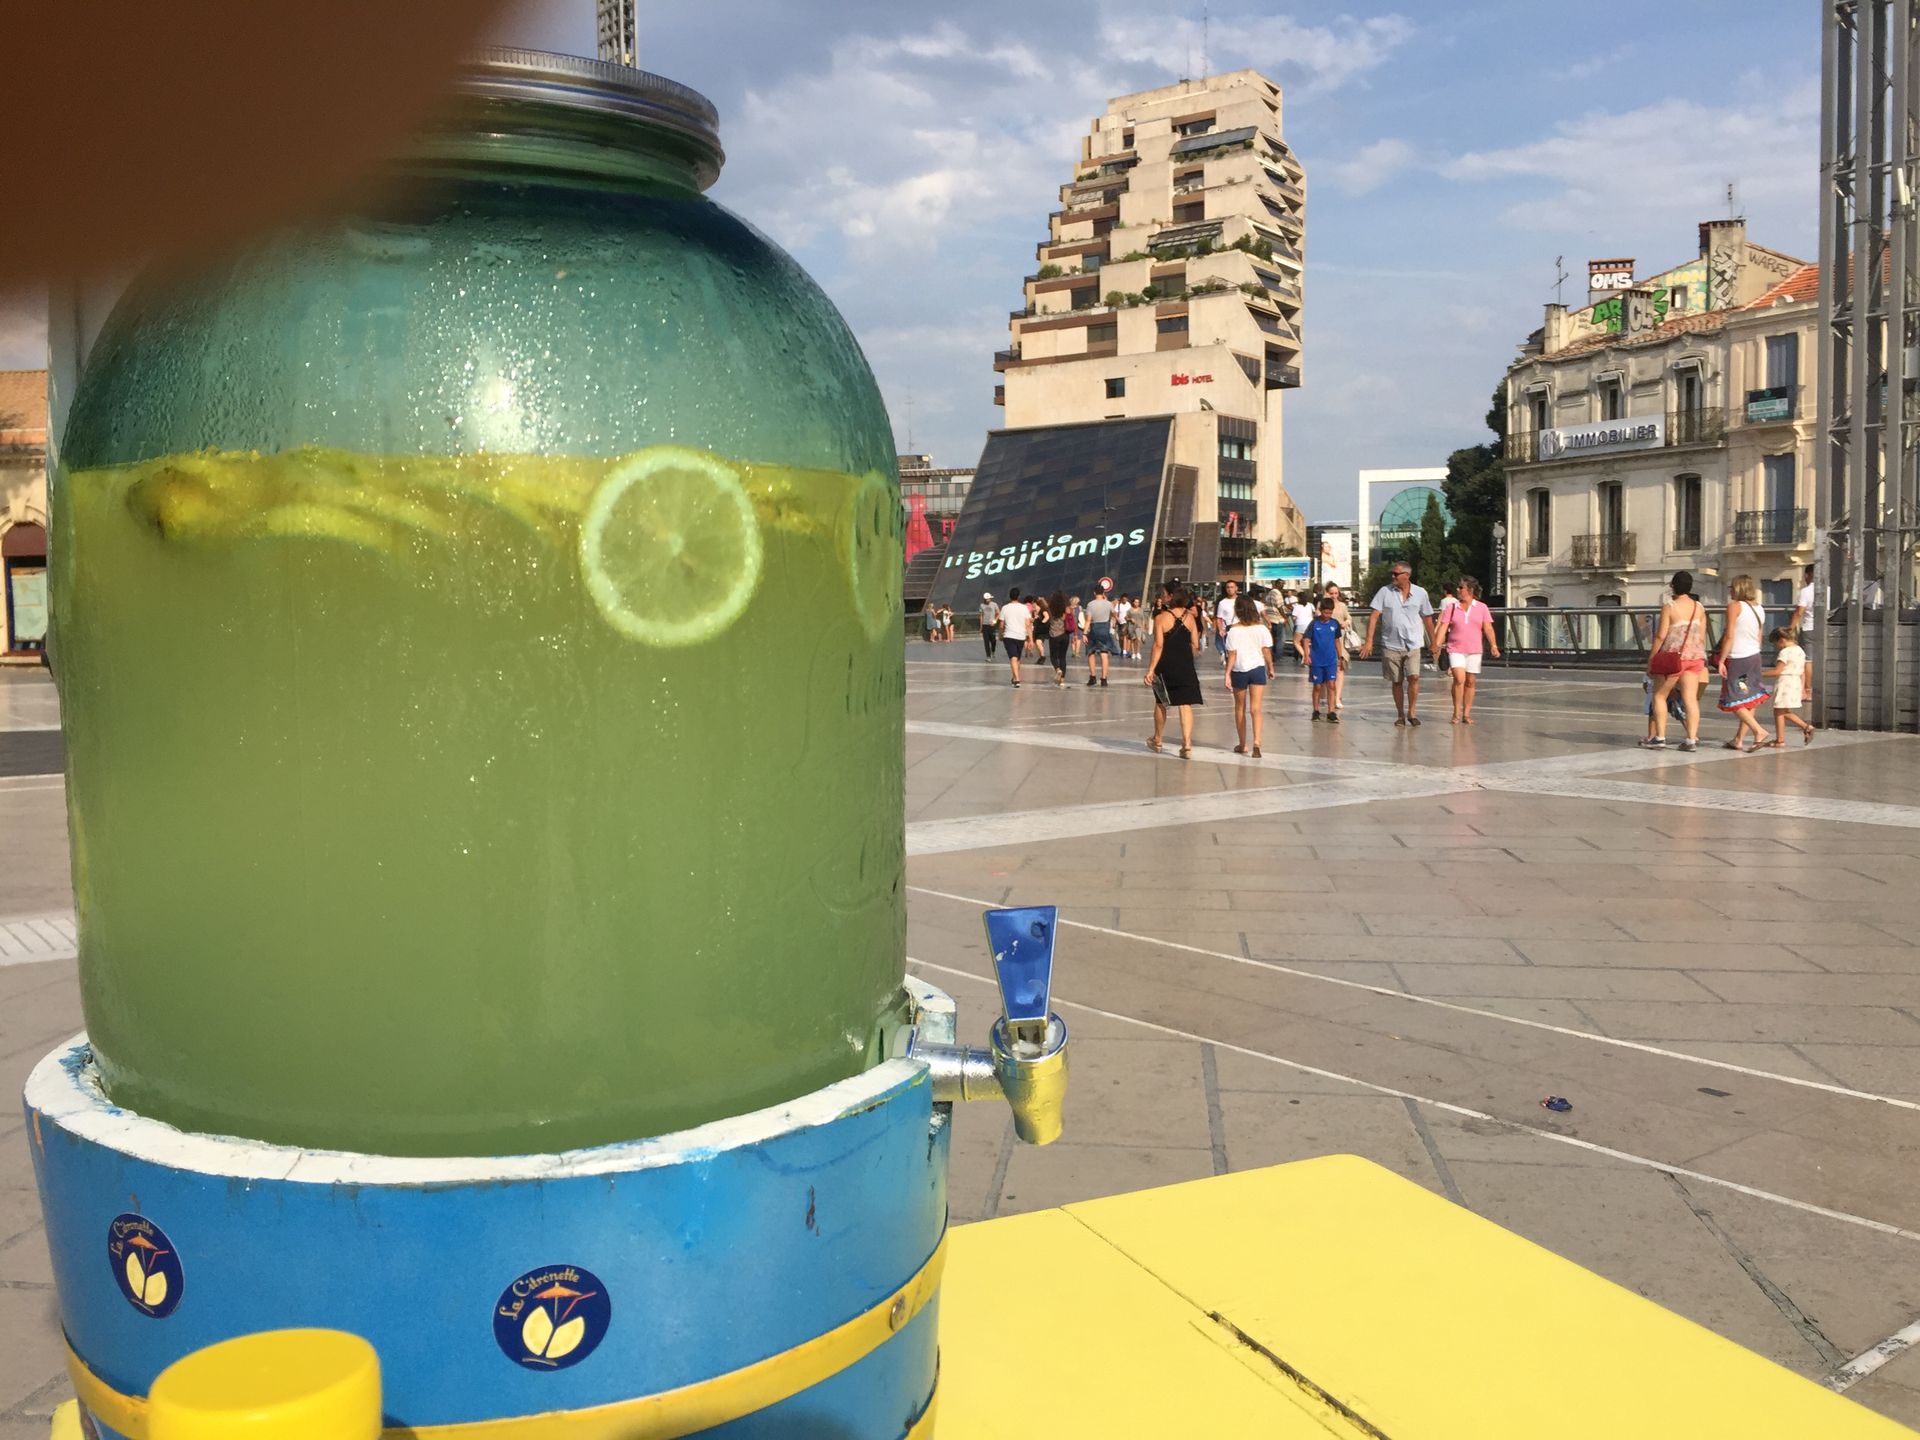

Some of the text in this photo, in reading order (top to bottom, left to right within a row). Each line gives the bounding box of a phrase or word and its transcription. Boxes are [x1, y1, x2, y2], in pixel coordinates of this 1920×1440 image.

[1591, 272, 1634, 290] OMS
[1192, 374, 1214, 384] HOTEL
[1570, 424, 1660, 449] IMMOBILIER
[945, 534, 1073, 568] librairie
[965, 528, 1146, 580] sauramps
[499, 1299, 525, 1320] La
